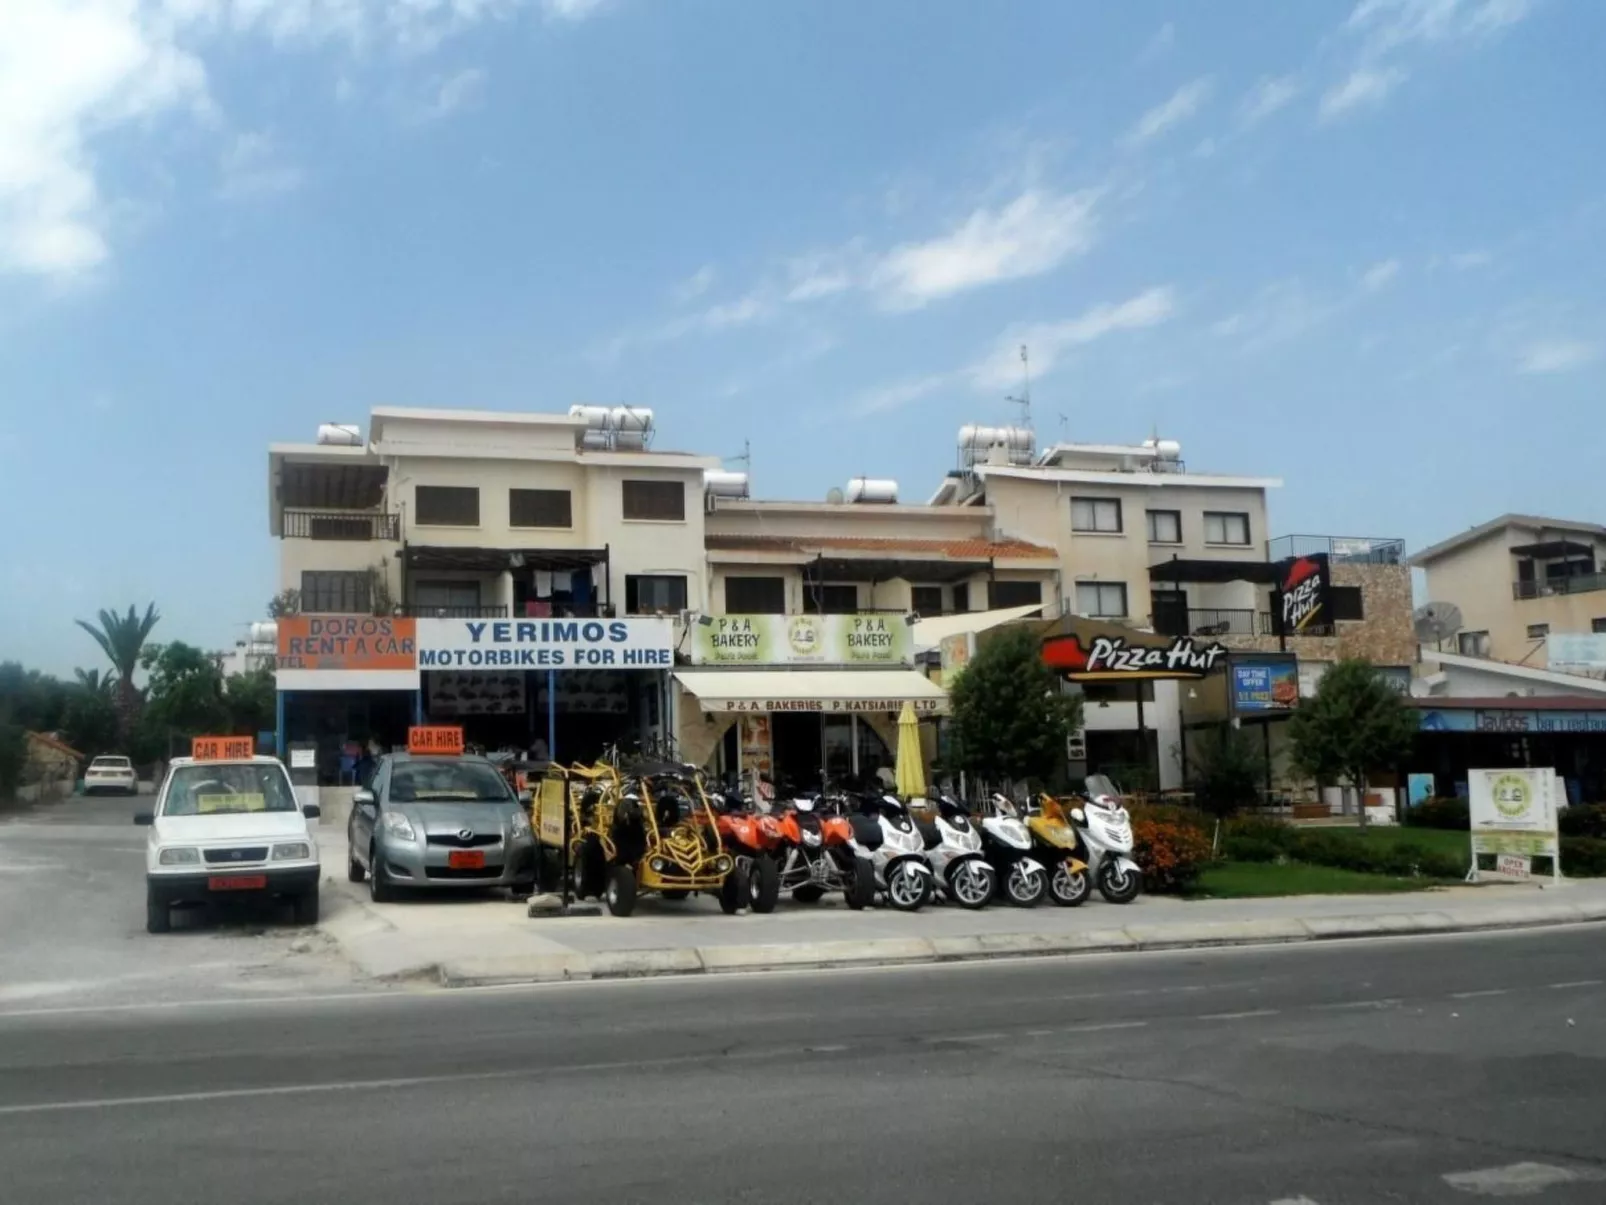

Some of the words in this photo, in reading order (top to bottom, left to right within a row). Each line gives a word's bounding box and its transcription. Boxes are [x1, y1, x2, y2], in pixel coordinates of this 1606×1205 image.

[1283, 575, 1321, 620] Pizza
[1291, 592, 1321, 629] Hut
[310, 619, 392, 636] DOROS
[466, 622, 629, 642] YERIMOS
[719, 618, 727, 631] P
[732, 618, 739, 631] &
[744, 618, 751, 631] A
[855, 618, 862, 631] P
[867, 618, 874, 631] &
[878, 618, 885, 631] A
[290, 637, 348, 655] RENT
[355, 638, 367, 655] A
[375, 638, 414, 655] CAR
[711, 634, 760, 648] BAKERY
[847, 634, 894, 648] BAKERY
[420, 649, 566, 666] MOTORBIKES
[574, 649, 616, 665] FOR
[623, 649, 671, 664] HIRE
[1087, 637, 1162, 672] Pizza
[1166, 639, 1226, 669] Hut
[1243, 679, 1264, 687] OFFER
[726, 701, 735, 711] P
[738, 701, 746, 710] &
[750, 701, 760, 711] A
[766, 701, 823, 711] BAKERIES
[914, 700, 937, 710] LTD
[412, 731, 434, 747] CAR
[437, 732, 461, 748] HIRE
[195, 743, 218, 760] CAR
[225, 743, 253, 758] HIRE
